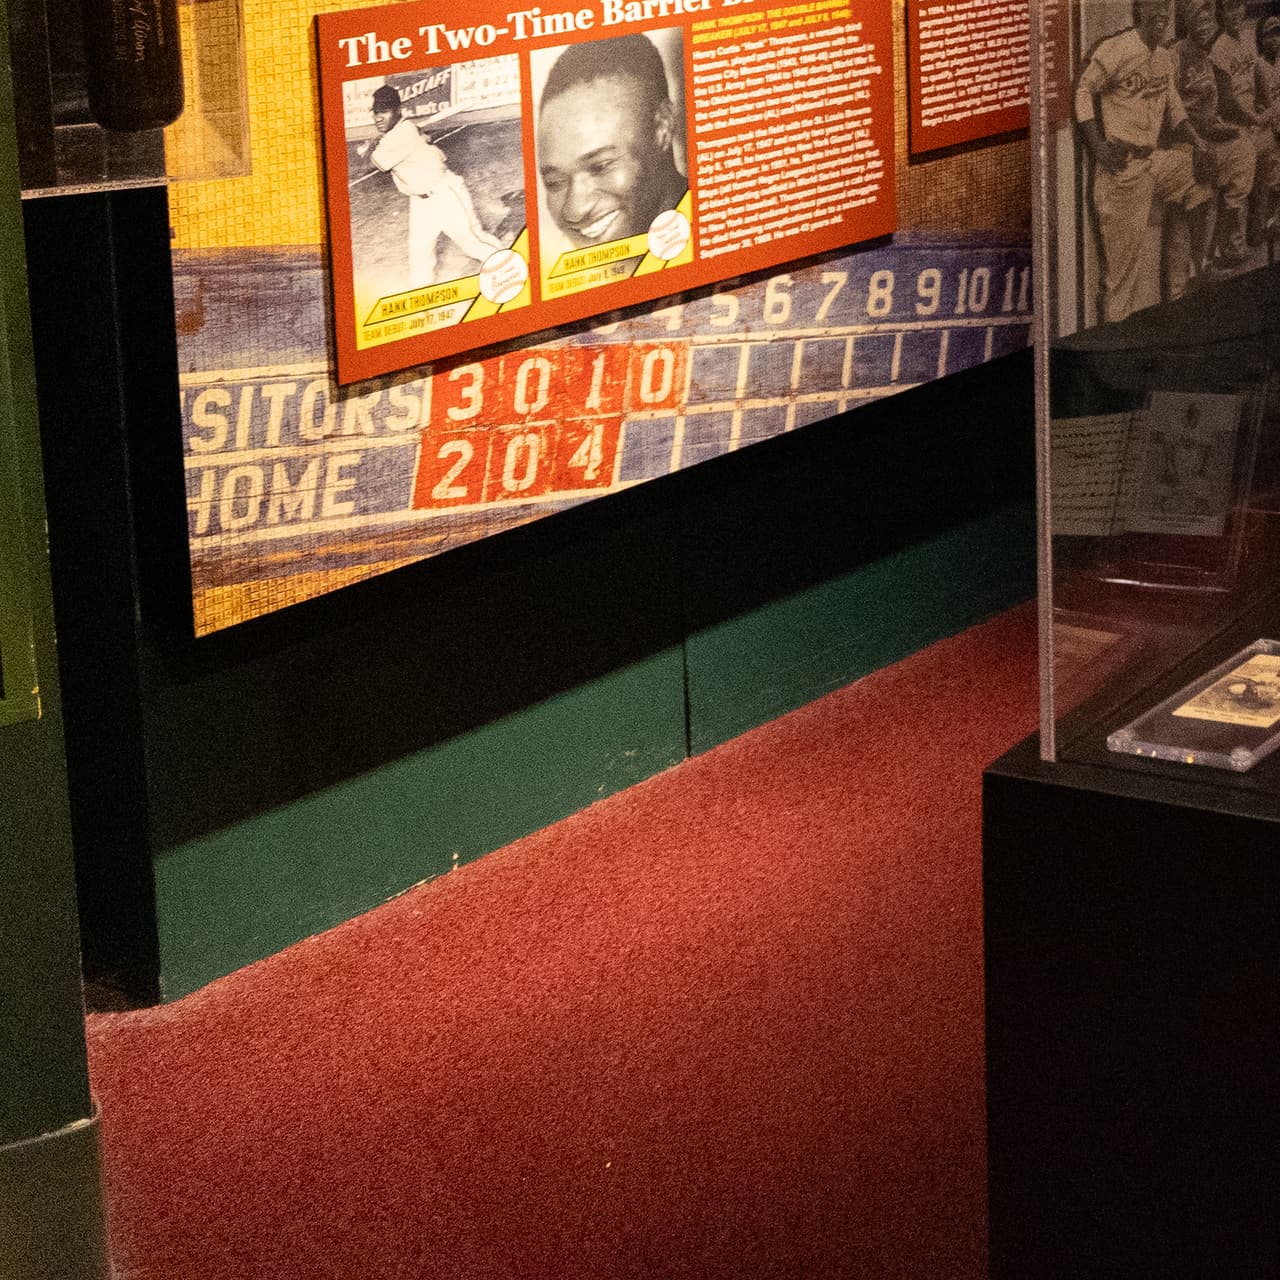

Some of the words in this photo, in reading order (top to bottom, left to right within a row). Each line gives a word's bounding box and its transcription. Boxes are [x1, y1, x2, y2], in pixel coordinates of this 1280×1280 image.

[338, 31, 413, 68] The
[419, 1, 595, 56] Two-Time
[763, 274, 795, 322] 6
[813, 271, 848, 321] 7
[866, 269, 895, 318] 8
[916, 267, 942, 316] 9
[954, 267, 989, 315] 10
[188, 378, 421, 452] SITORS
[447, 362, 485, 421] 3
[513, 357, 551, 414] 0
[585, 353, 605, 409] 1
[640, 349, 676, 403] 0
[430, 439, 474, 500] 2
[503, 432, 541, 493] 0
[567, 424, 604, 481] 4
